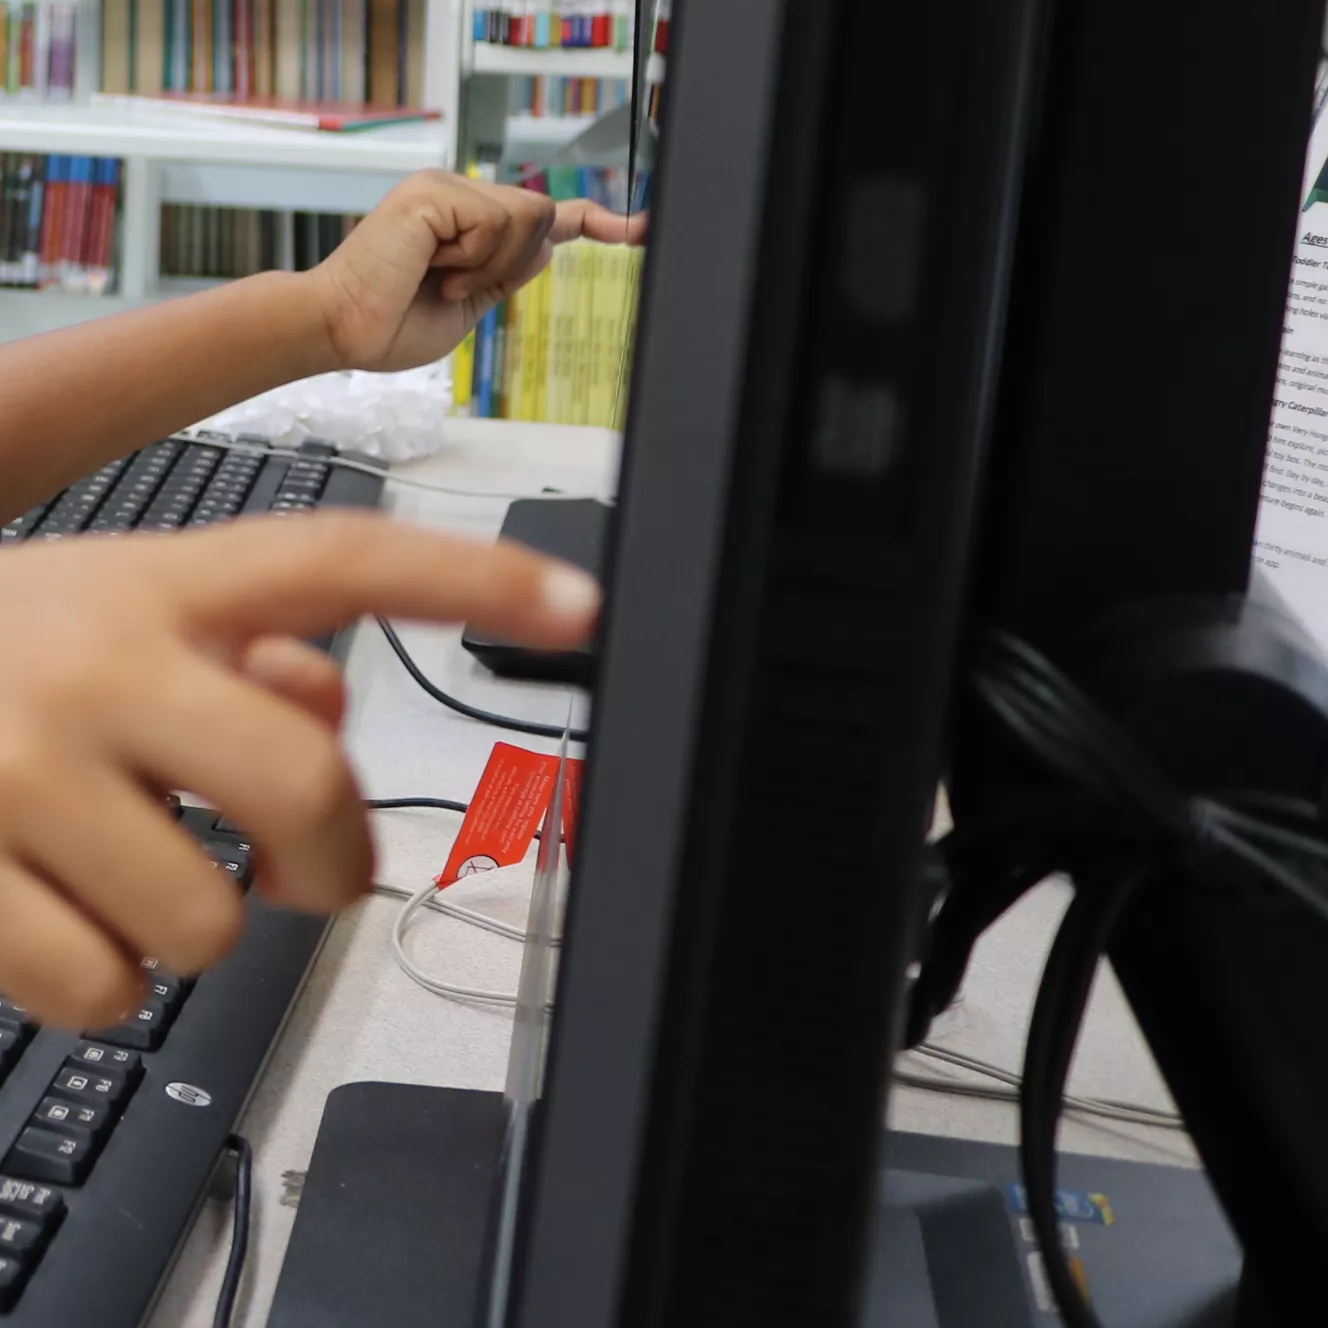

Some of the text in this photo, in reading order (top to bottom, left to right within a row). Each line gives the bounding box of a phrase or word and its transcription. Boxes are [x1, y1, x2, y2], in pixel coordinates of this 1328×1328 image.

[1302, 231, 1328, 246] Ages
[153, 984, 168, 995] F7
[113, 1050, 129, 1062] F9
